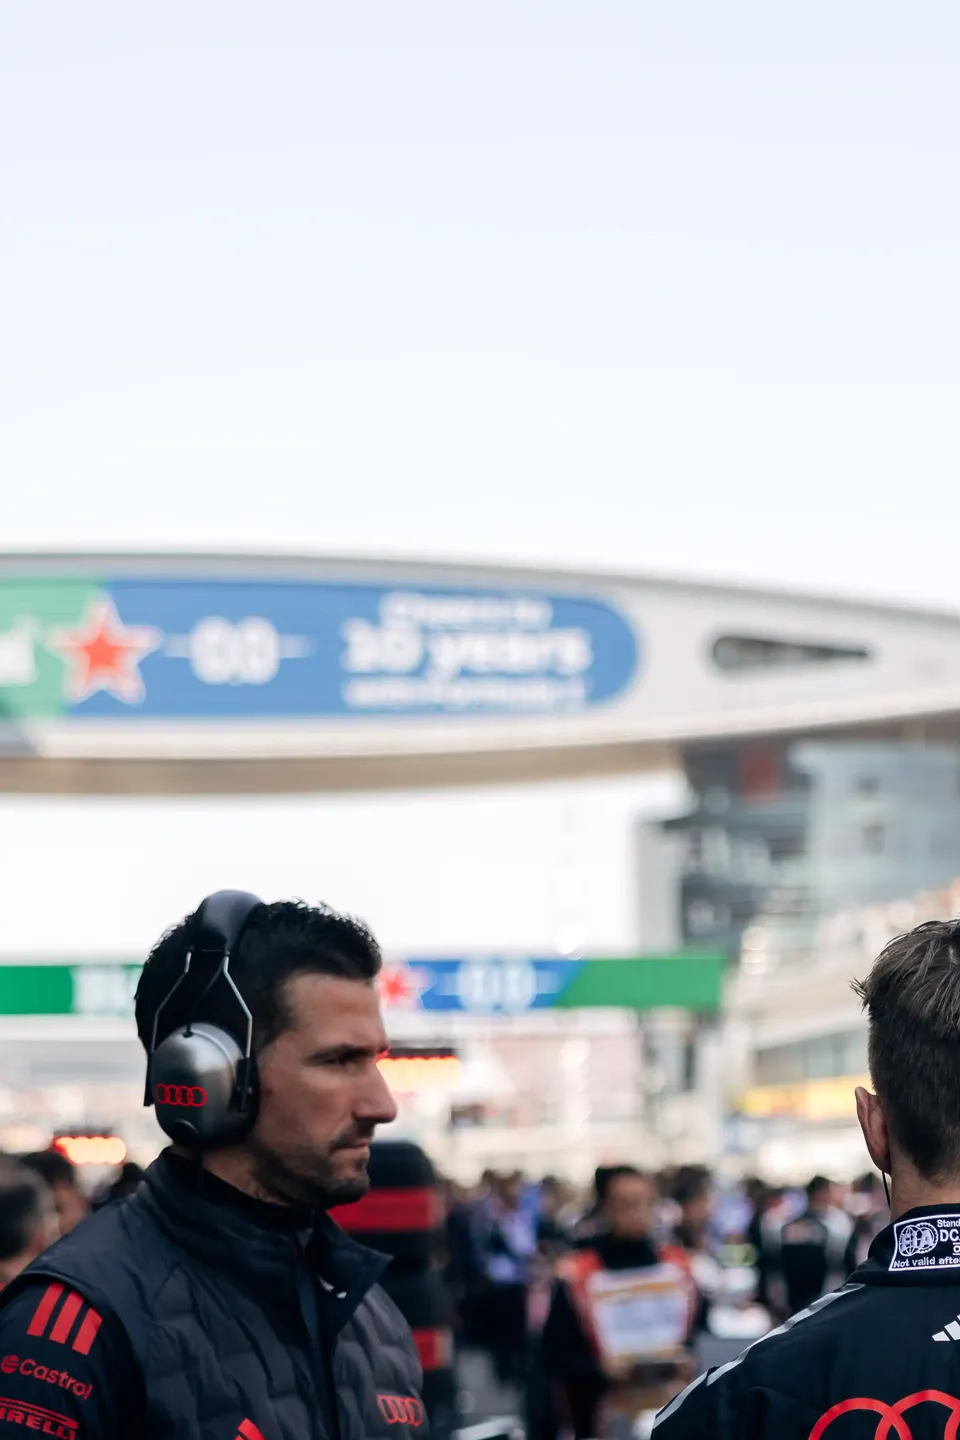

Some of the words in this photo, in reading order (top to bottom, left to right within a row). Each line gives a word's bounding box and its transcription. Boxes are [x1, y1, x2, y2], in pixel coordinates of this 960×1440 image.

[894, 1258, 910, 1268] Not
[912, 1256, 936, 1266] valid
[19, 1357, 93, 1400] Castrol
